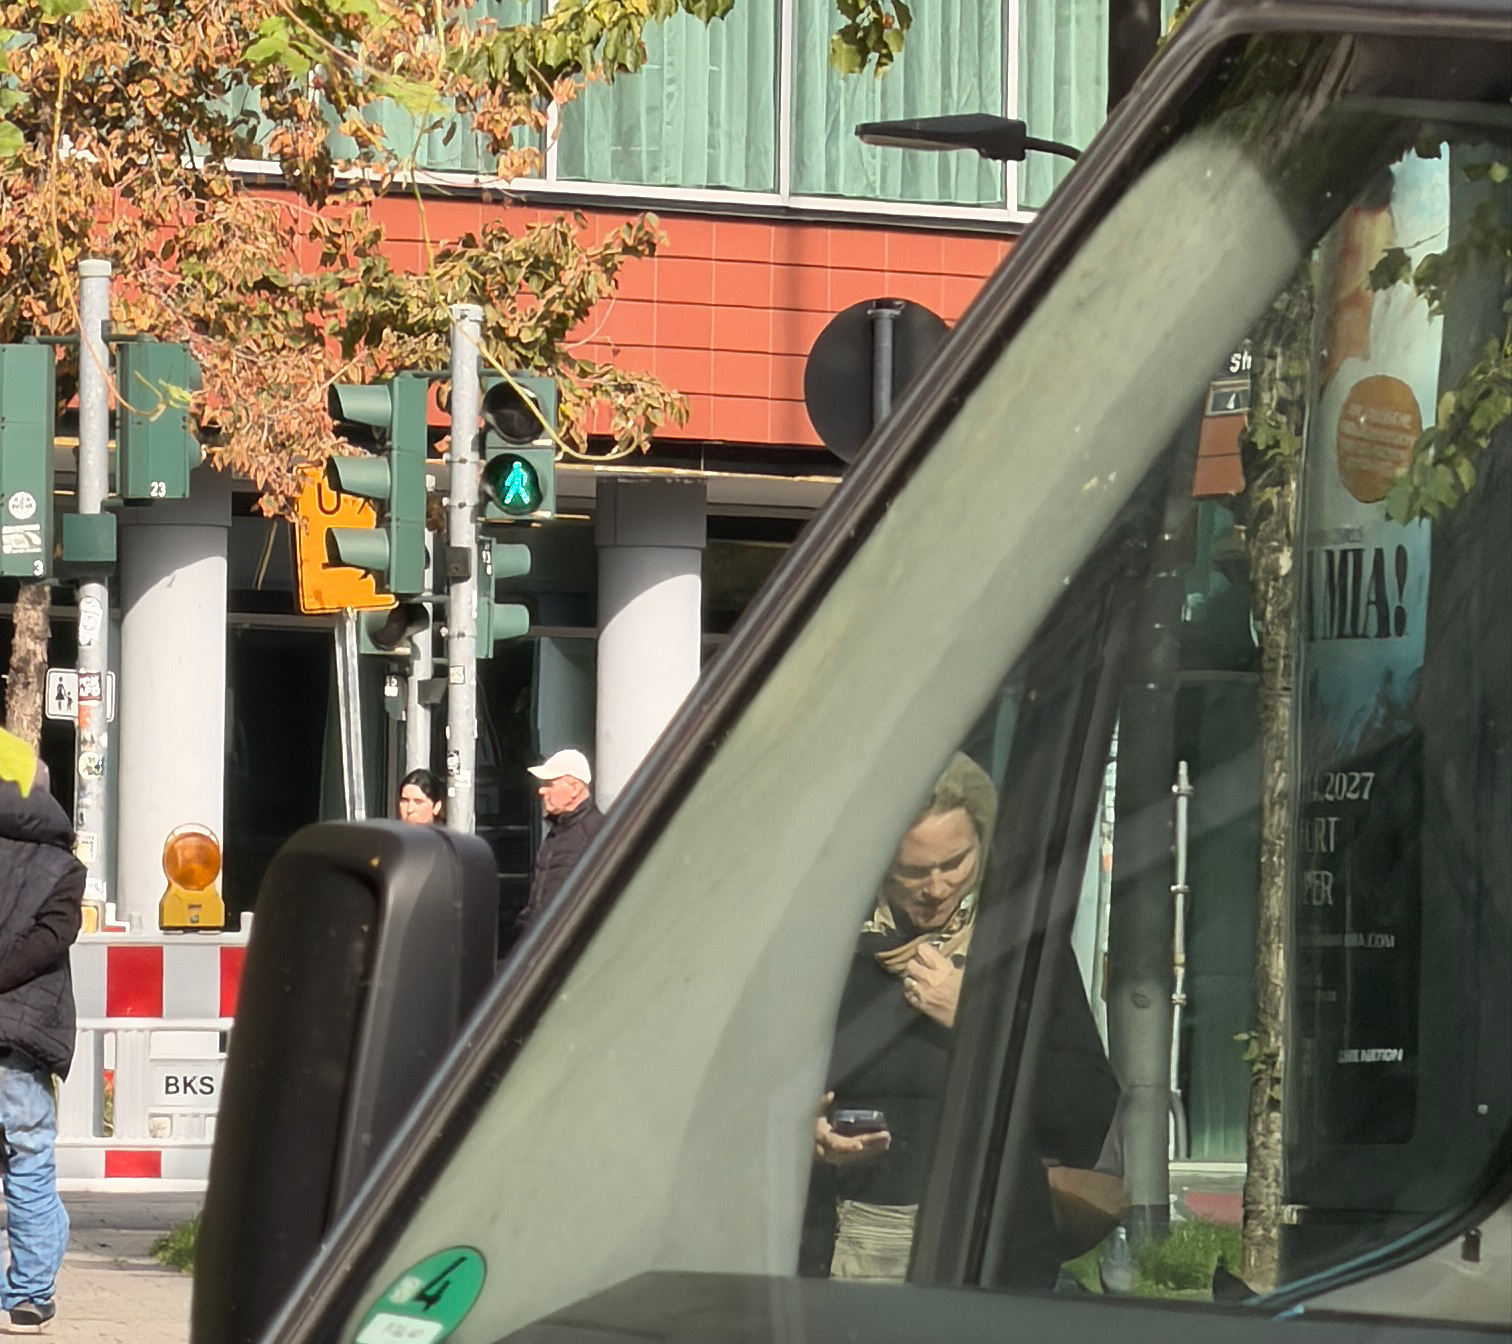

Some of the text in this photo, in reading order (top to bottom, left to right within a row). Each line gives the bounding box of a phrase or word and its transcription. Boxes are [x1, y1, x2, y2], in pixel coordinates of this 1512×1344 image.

[150, 481, 167, 498] 23
[33, 559, 44, 576] 3
[164, 1075, 215, 1096] BKS
[414, 1256, 468, 1312] 4
